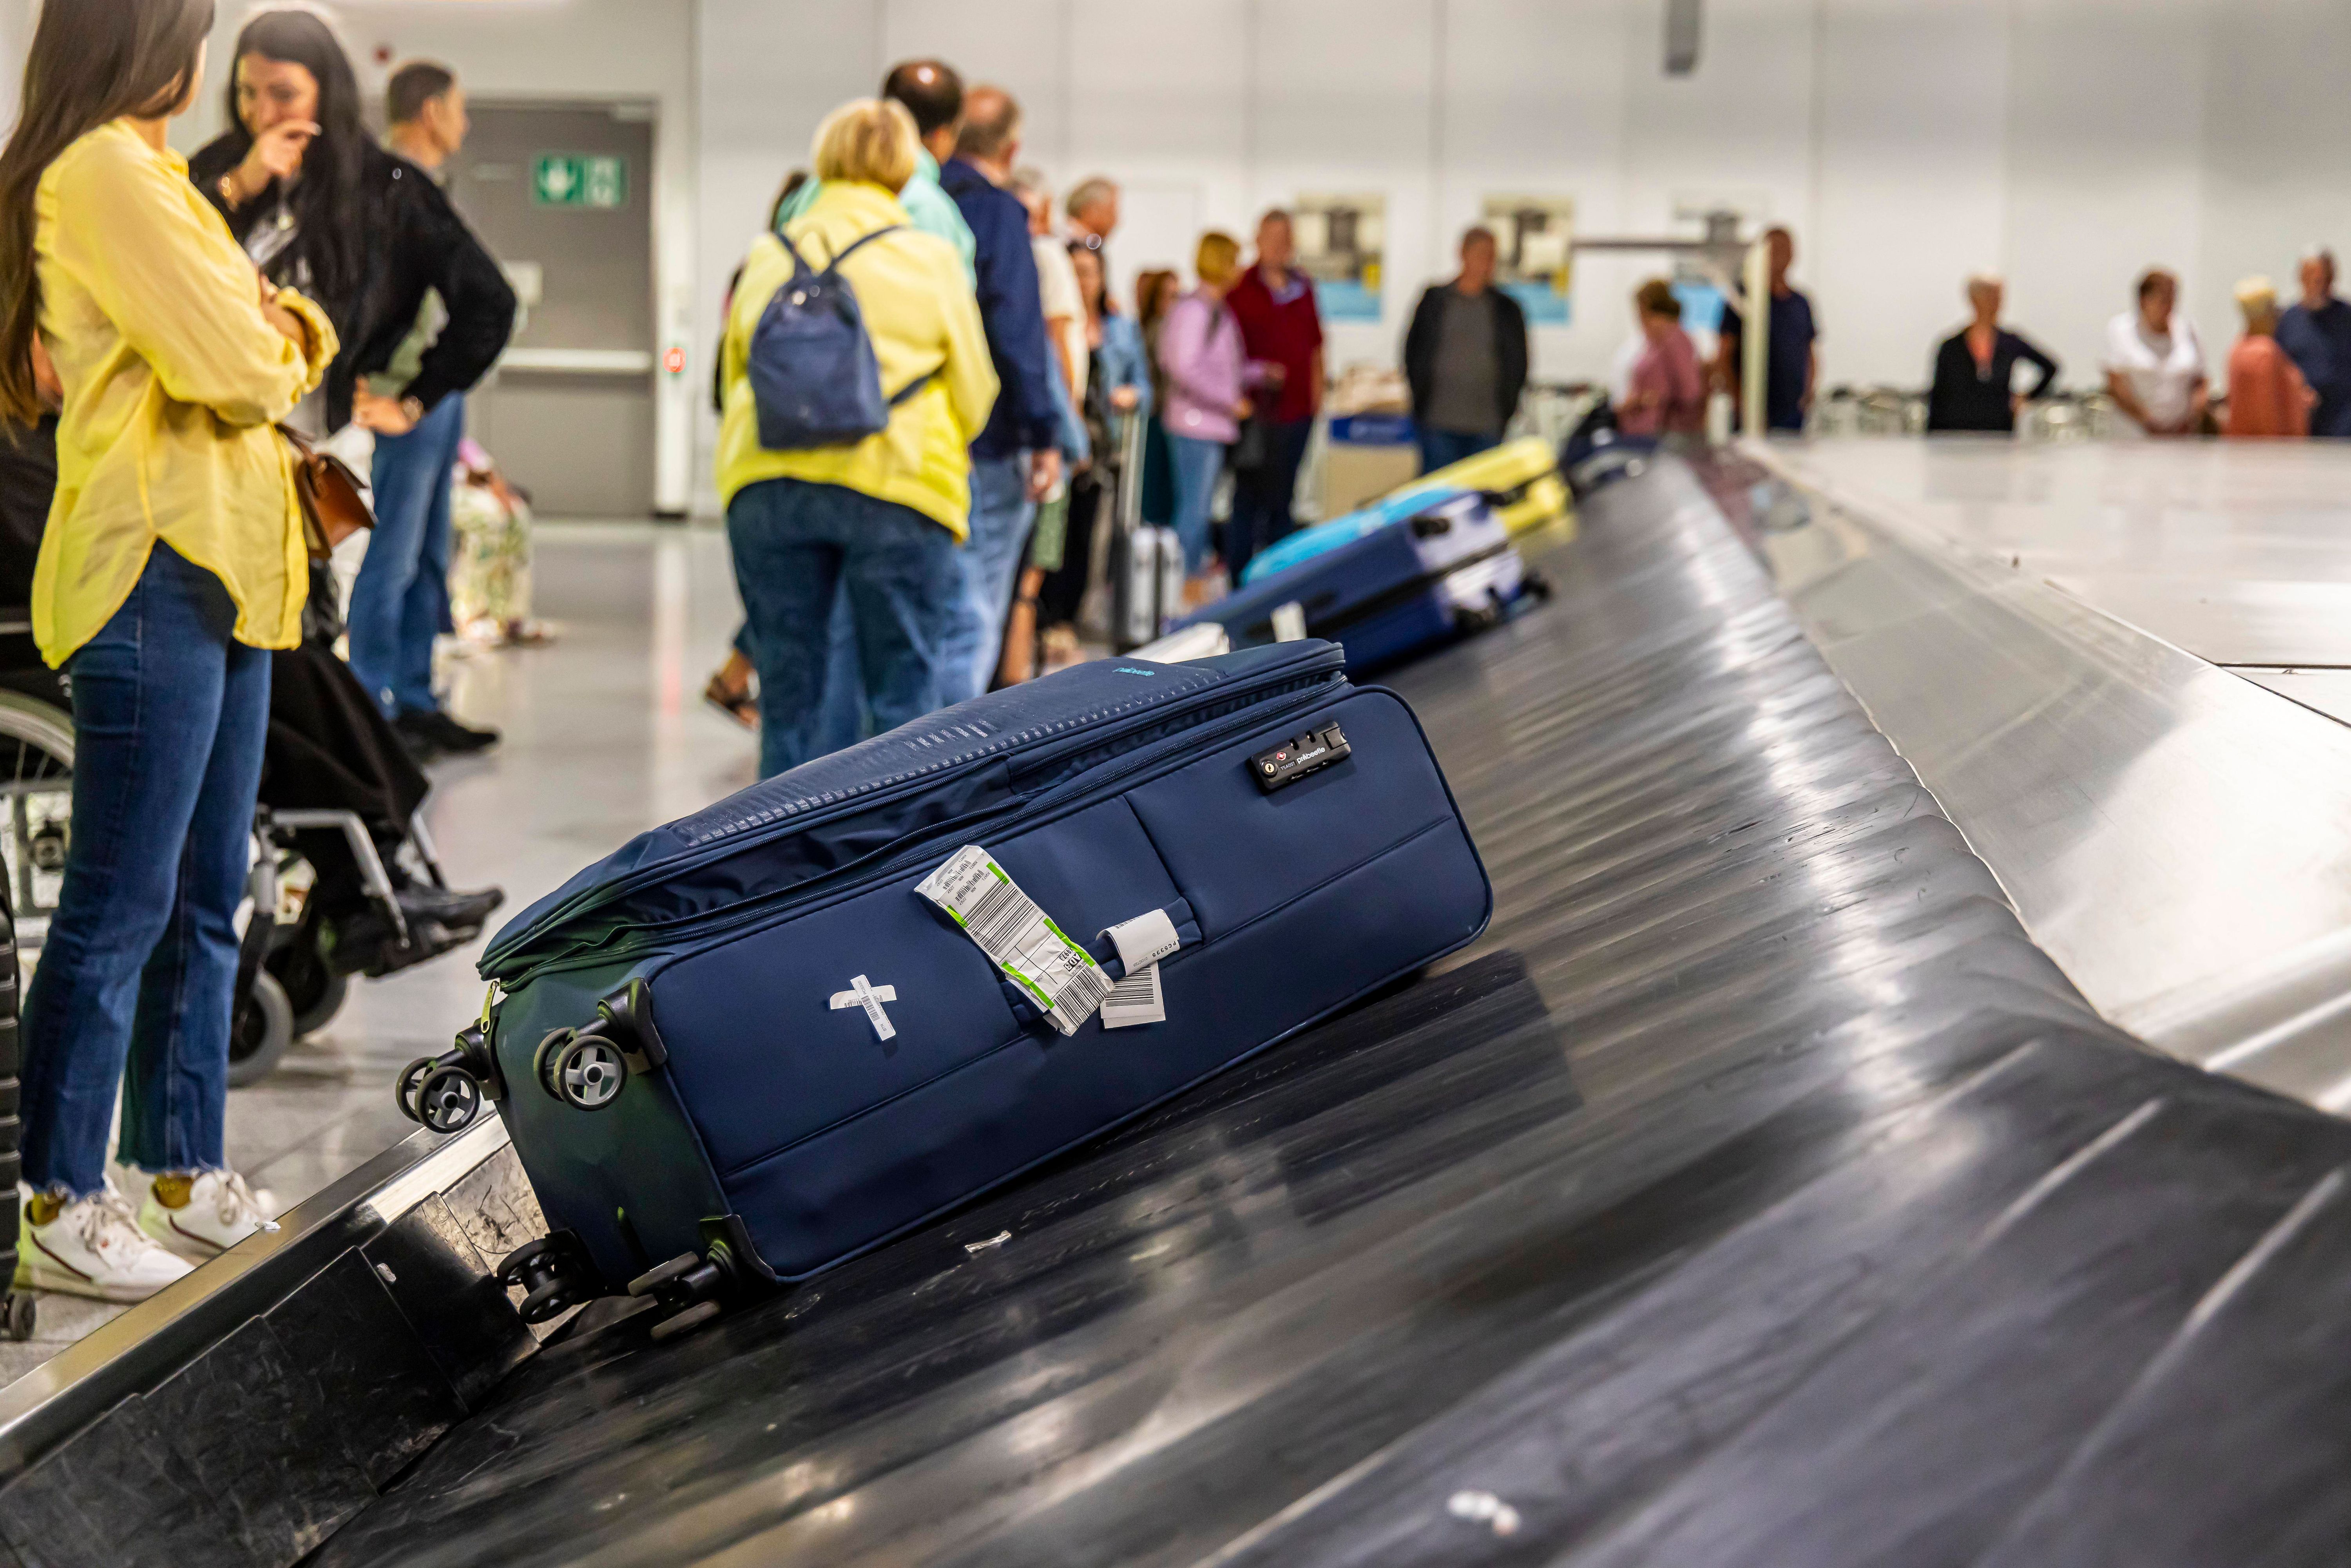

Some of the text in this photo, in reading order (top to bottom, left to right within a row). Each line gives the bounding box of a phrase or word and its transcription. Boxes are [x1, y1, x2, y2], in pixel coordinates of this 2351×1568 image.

[1280, 761, 1295, 771] TSA007
[1059, 947, 1074, 961] XQ973
[1152, 941, 1177, 957] PC5335
[1064, 953, 1081, 970] ADB
